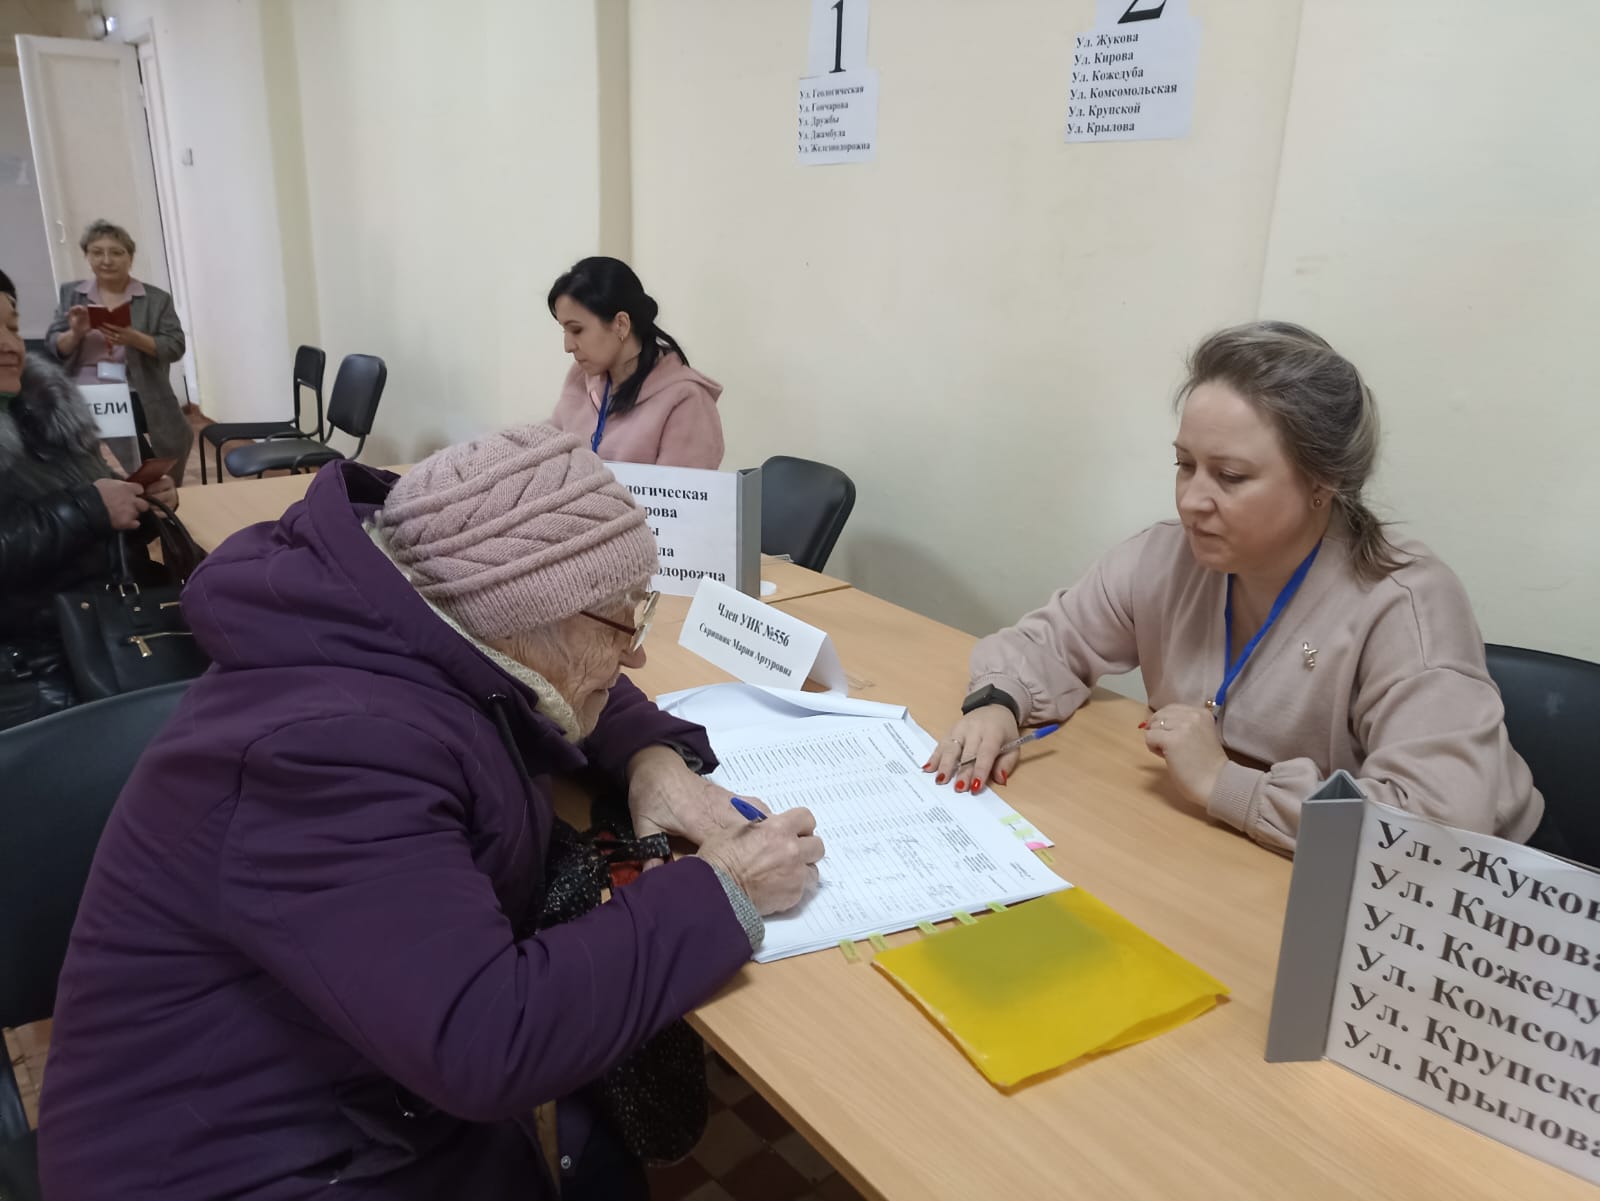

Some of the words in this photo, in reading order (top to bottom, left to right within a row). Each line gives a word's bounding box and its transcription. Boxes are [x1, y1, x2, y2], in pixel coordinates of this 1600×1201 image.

[829, 0, 846, 73] 1
[1074, 54, 1091, 66] Ул.
[1094, 52, 1134, 66] Кирова
[1076, 37, 1093, 48] Ул.
[1097, 33, 1139, 48] Жукова
[1070, 89, 1087, 100] Ул.
[1090, 84, 1178, 99] Комсомольская
[1072, 72, 1089, 83] Ул.
[1092, 67, 1144, 82] Кожедуба
[1067, 123, 1084, 134] Ул.
[1086, 122, 1135, 136] Крылова
[1068, 106, 1086, 117] Ул.
[1088, 103, 1141, 118] Крупской
[718, 602, 739, 623] Член
[740, 613, 764, 634] УИК
[762, 624, 790, 647] №556
[732, 638, 754, 657] Мария
[754, 652, 792, 677] Артуровна
[1378, 820, 1442, 866] Ул.
[1370, 861, 1433, 908] Ул.
[1363, 903, 1425, 951] Ул.
[1350, 982, 1408, 1032] Ул.
[1356, 943, 1415, 993] Ул.
[1429, 975, 1600, 1067] Комсом
[1344, 1021, 1401, 1071] Ул.
